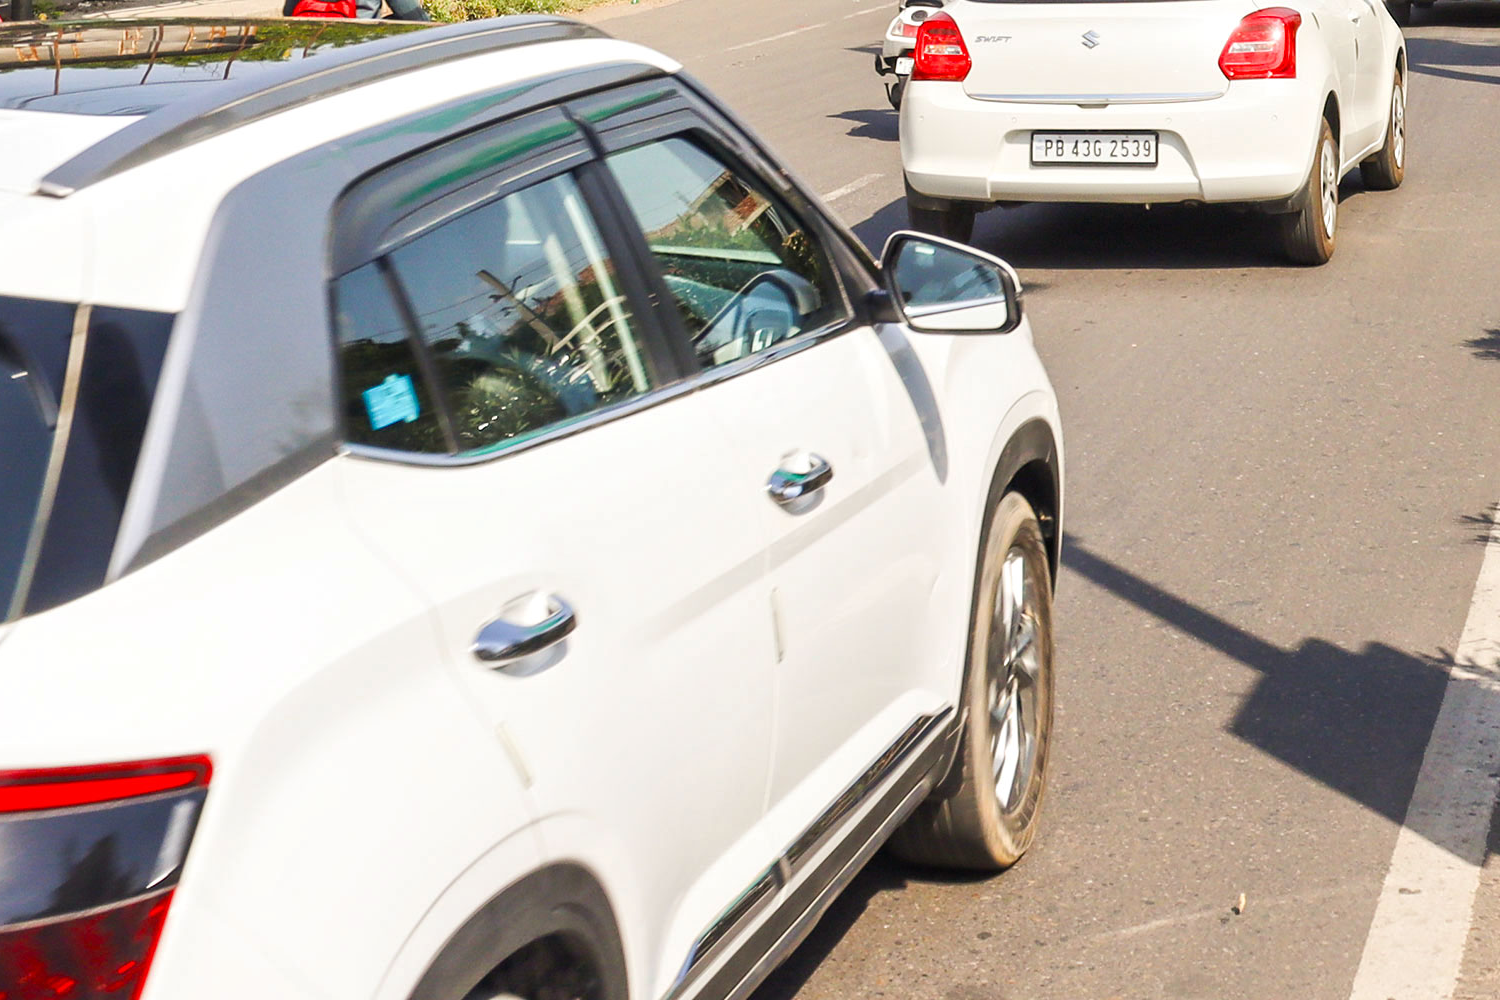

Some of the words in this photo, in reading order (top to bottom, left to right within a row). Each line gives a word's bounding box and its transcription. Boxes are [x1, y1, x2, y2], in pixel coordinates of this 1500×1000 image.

[1045, 140, 1064, 157] PB
[1071, 140, 1102, 157] 43G
[1110, 140, 1151, 158] 2539
